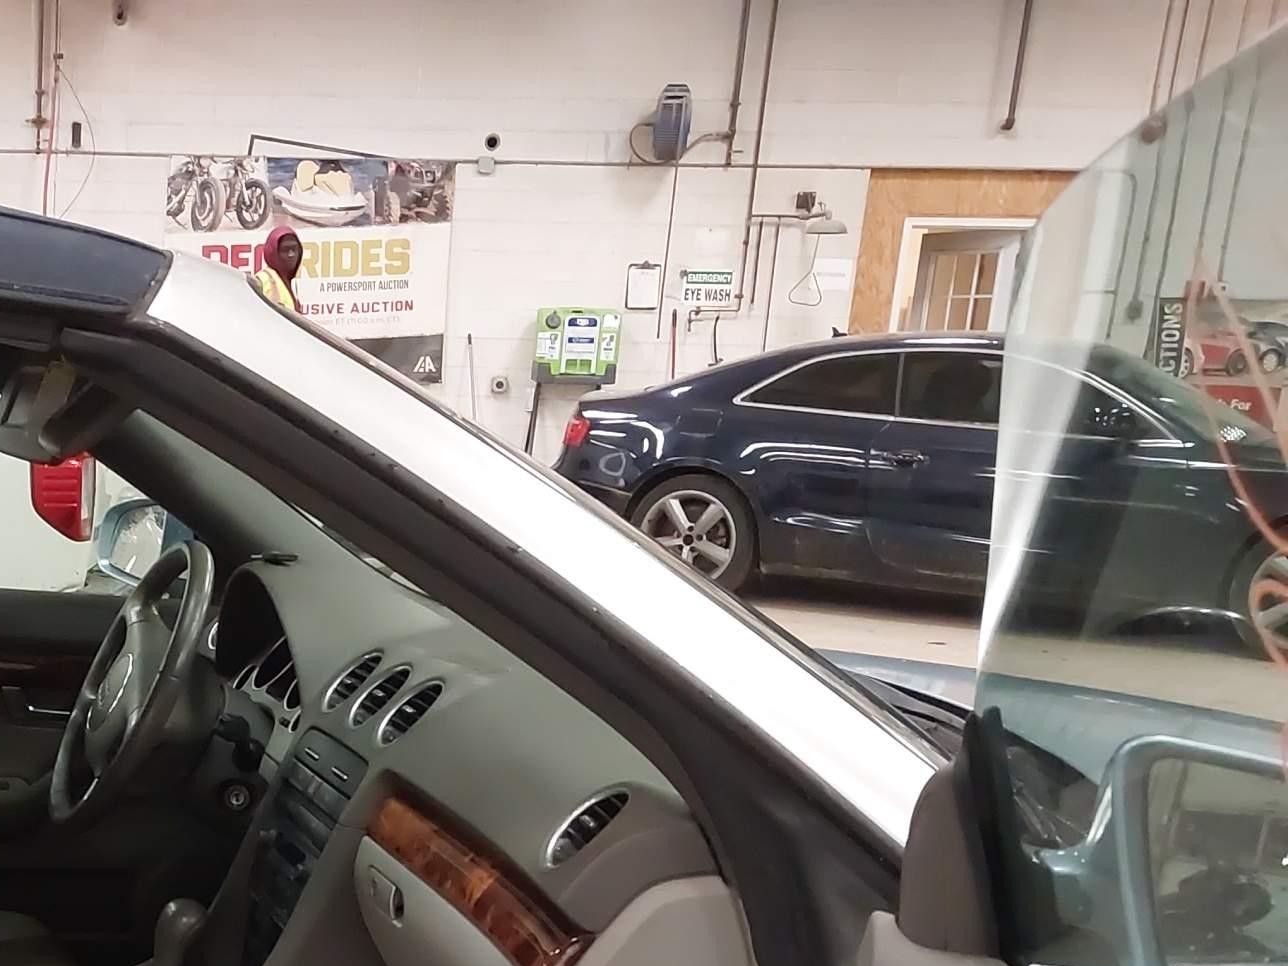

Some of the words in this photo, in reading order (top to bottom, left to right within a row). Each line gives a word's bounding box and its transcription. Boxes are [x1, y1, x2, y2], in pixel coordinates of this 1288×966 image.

[298, 238, 410, 278] RIDES
[687, 273, 732, 283] EMERGENCY
[319, 282, 325, 293] A
[326, 280, 377, 293] POWERSPORT
[378, 279, 409, 291] AUCTION
[684, 287, 702, 301] EYE
[704, 288, 732, 302] WASH
[302, 302, 345, 315] USIVE
[350, 299, 414, 314] AUCTION
